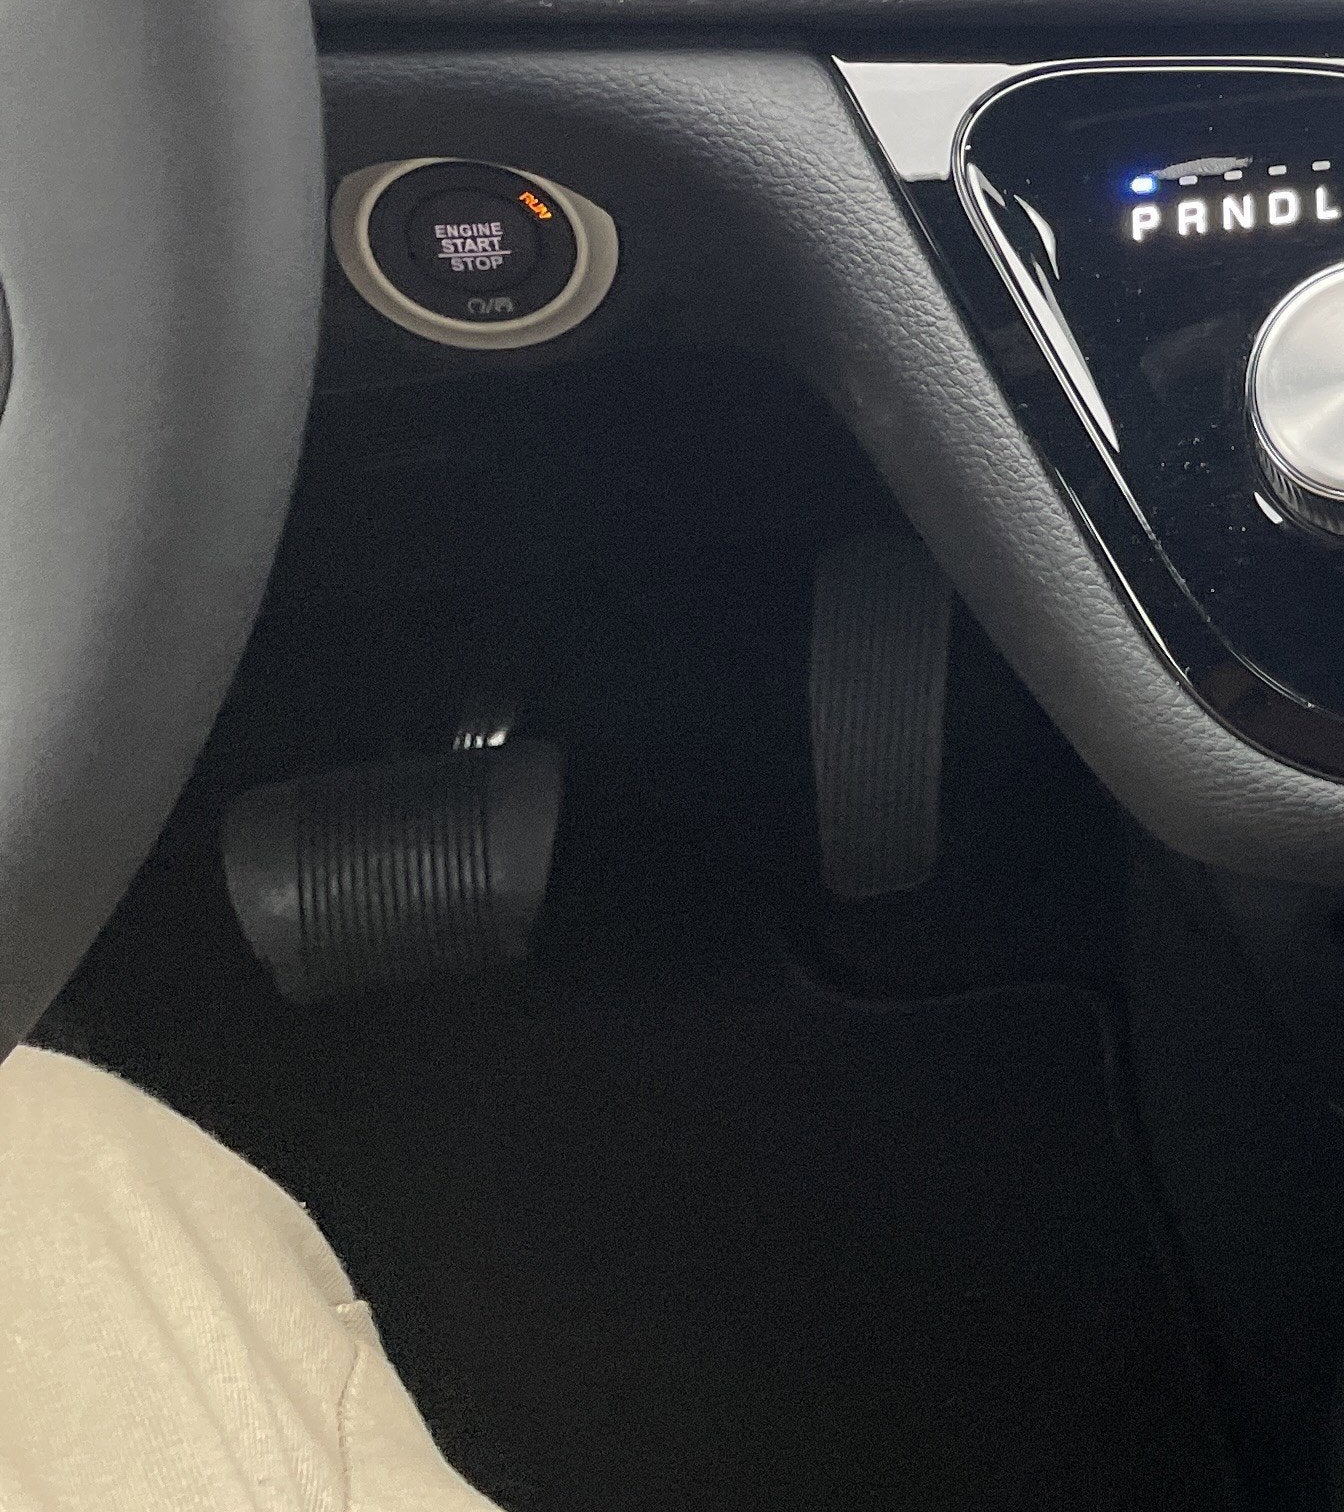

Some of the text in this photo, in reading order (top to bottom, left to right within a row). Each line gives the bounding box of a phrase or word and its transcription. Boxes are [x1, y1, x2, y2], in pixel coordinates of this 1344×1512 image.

[518, 191, 553, 220] RUN
[434, 221, 504, 239] ENGINE
[440, 237, 503, 254] START
[450, 255, 504, 272] STOP
